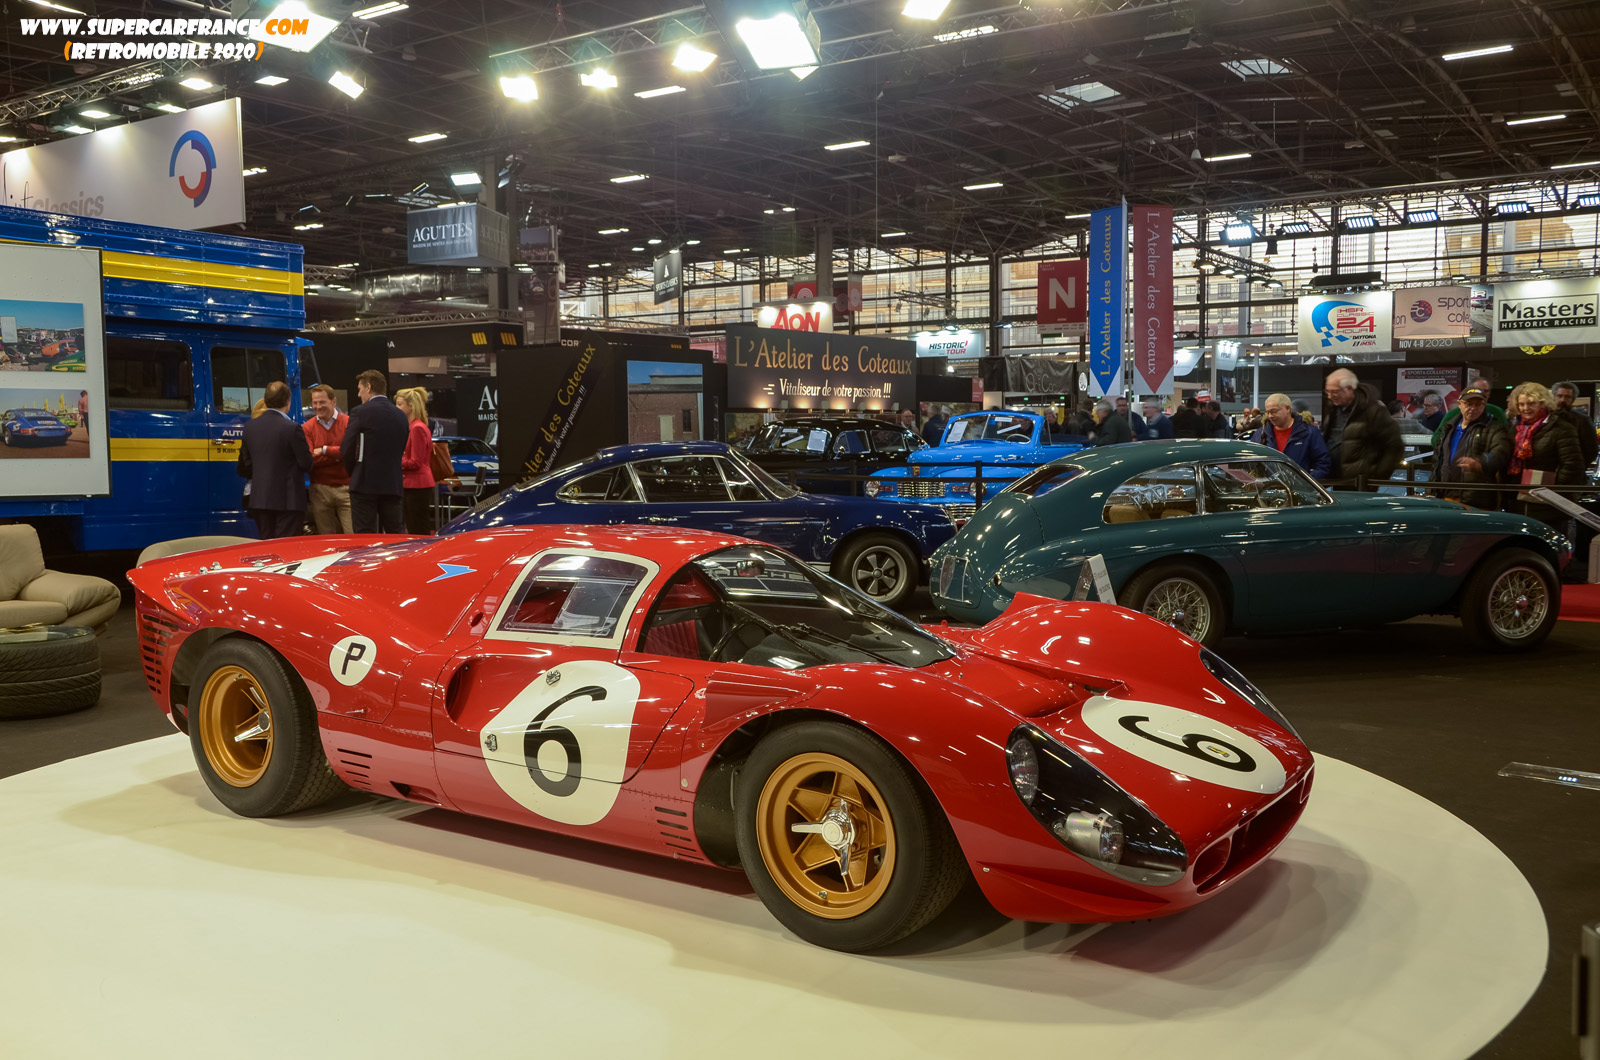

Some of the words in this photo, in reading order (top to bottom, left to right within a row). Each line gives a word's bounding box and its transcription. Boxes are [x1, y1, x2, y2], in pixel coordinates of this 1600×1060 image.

[412, 222, 473, 242] AGUTTES
[1100, 214, 1112, 273] Coteaux
[1147, 212, 1161, 278] L'Atelier
[1049, 277, 1076, 310] N
[1100, 280, 1111, 304] des
[1147, 285, 1160, 310] des
[770, 308, 820, 333] AON
[1337, 316, 1377, 332] 24
[1501, 320, 1549, 329] HISTORIC
[1554, 317, 1595, 326] RACING
[1502, 301, 1595, 320] Masters
[734, 335, 814, 370] L'Atelier
[821, 341, 849, 372] des
[857, 345, 913, 376] Coteaux
[929, 341, 966, 350] HISTORIC
[1100, 311, 1111, 376] L'Atelier
[1147, 317, 1161, 375] Coteaux
[1399, 340, 1412, 349] NOV
[1412, 339, 1424, 348] 4-8
[1425, 338, 1453, 348] 2020
[540, 413, 562, 443] des
[557, 344, 597, 406] Coteaux
[779, 378, 821, 397] Vitaliseur
[822, 379, 832, 397] de
[833, 383, 853, 398] votre
[852, 385, 881, 403] passion
[567, 396, 583, 426] passion
[340, 642, 366, 676] P
[523, 685, 608, 797] 6
[1118, 715, 1257, 773] 6
